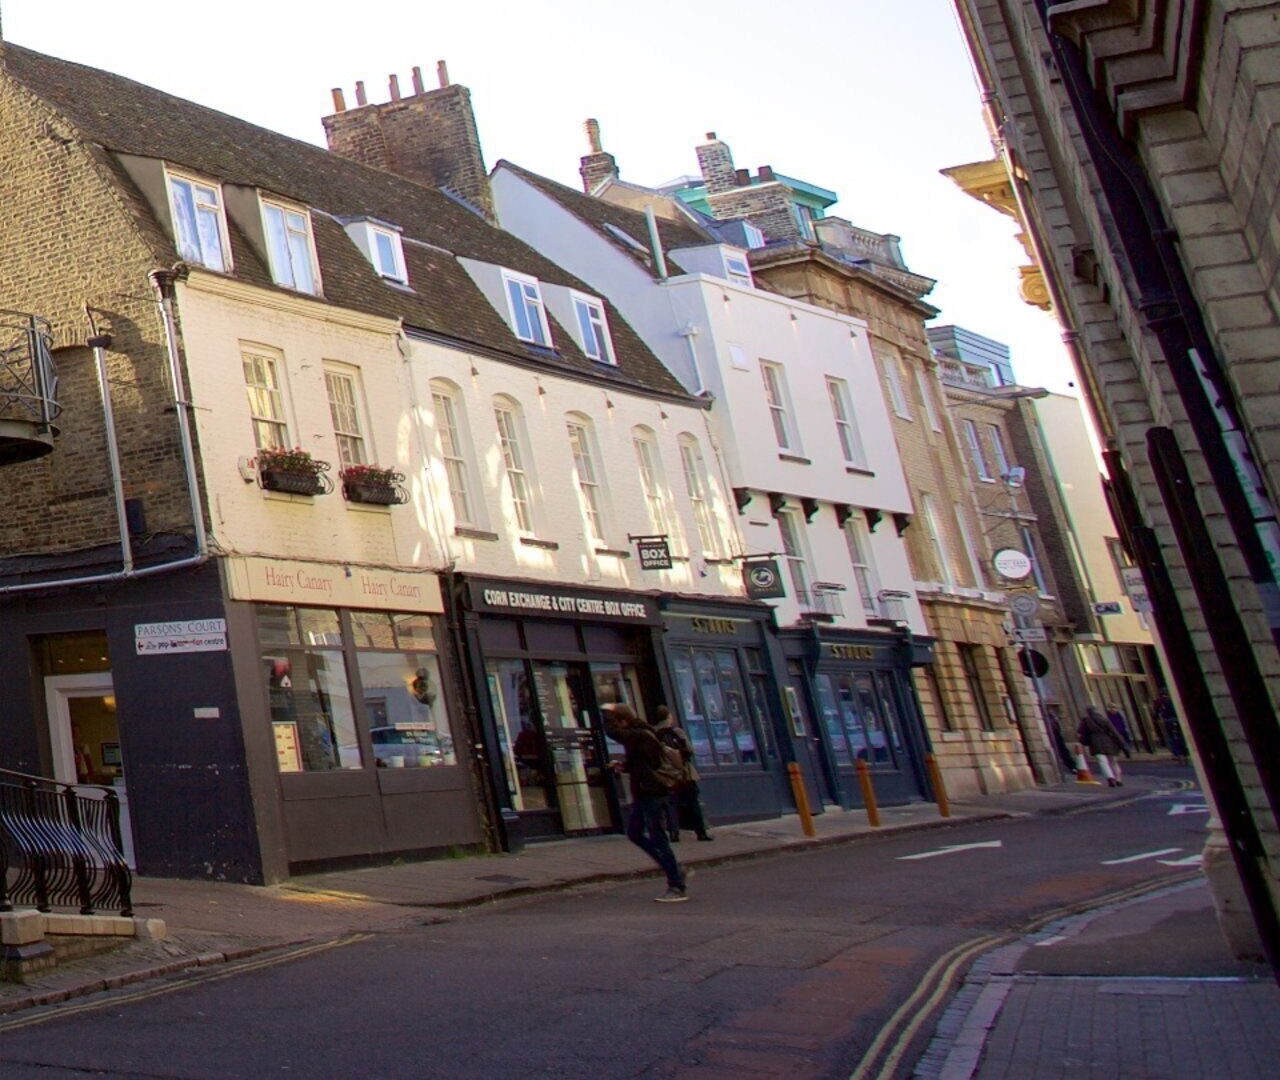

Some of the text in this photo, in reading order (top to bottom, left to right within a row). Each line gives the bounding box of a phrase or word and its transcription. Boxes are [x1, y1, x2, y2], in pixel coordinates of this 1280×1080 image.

[641, 549, 667, 559] BOX
[265, 566, 332, 596] Hairy Canary
[361, 576, 422, 602] Hairy Canary
[484, 589, 647, 618] CORN EXCHANGE & CITY CENTRE BOX OFFICE
[137, 621, 222, 636] PARSONS COURT
